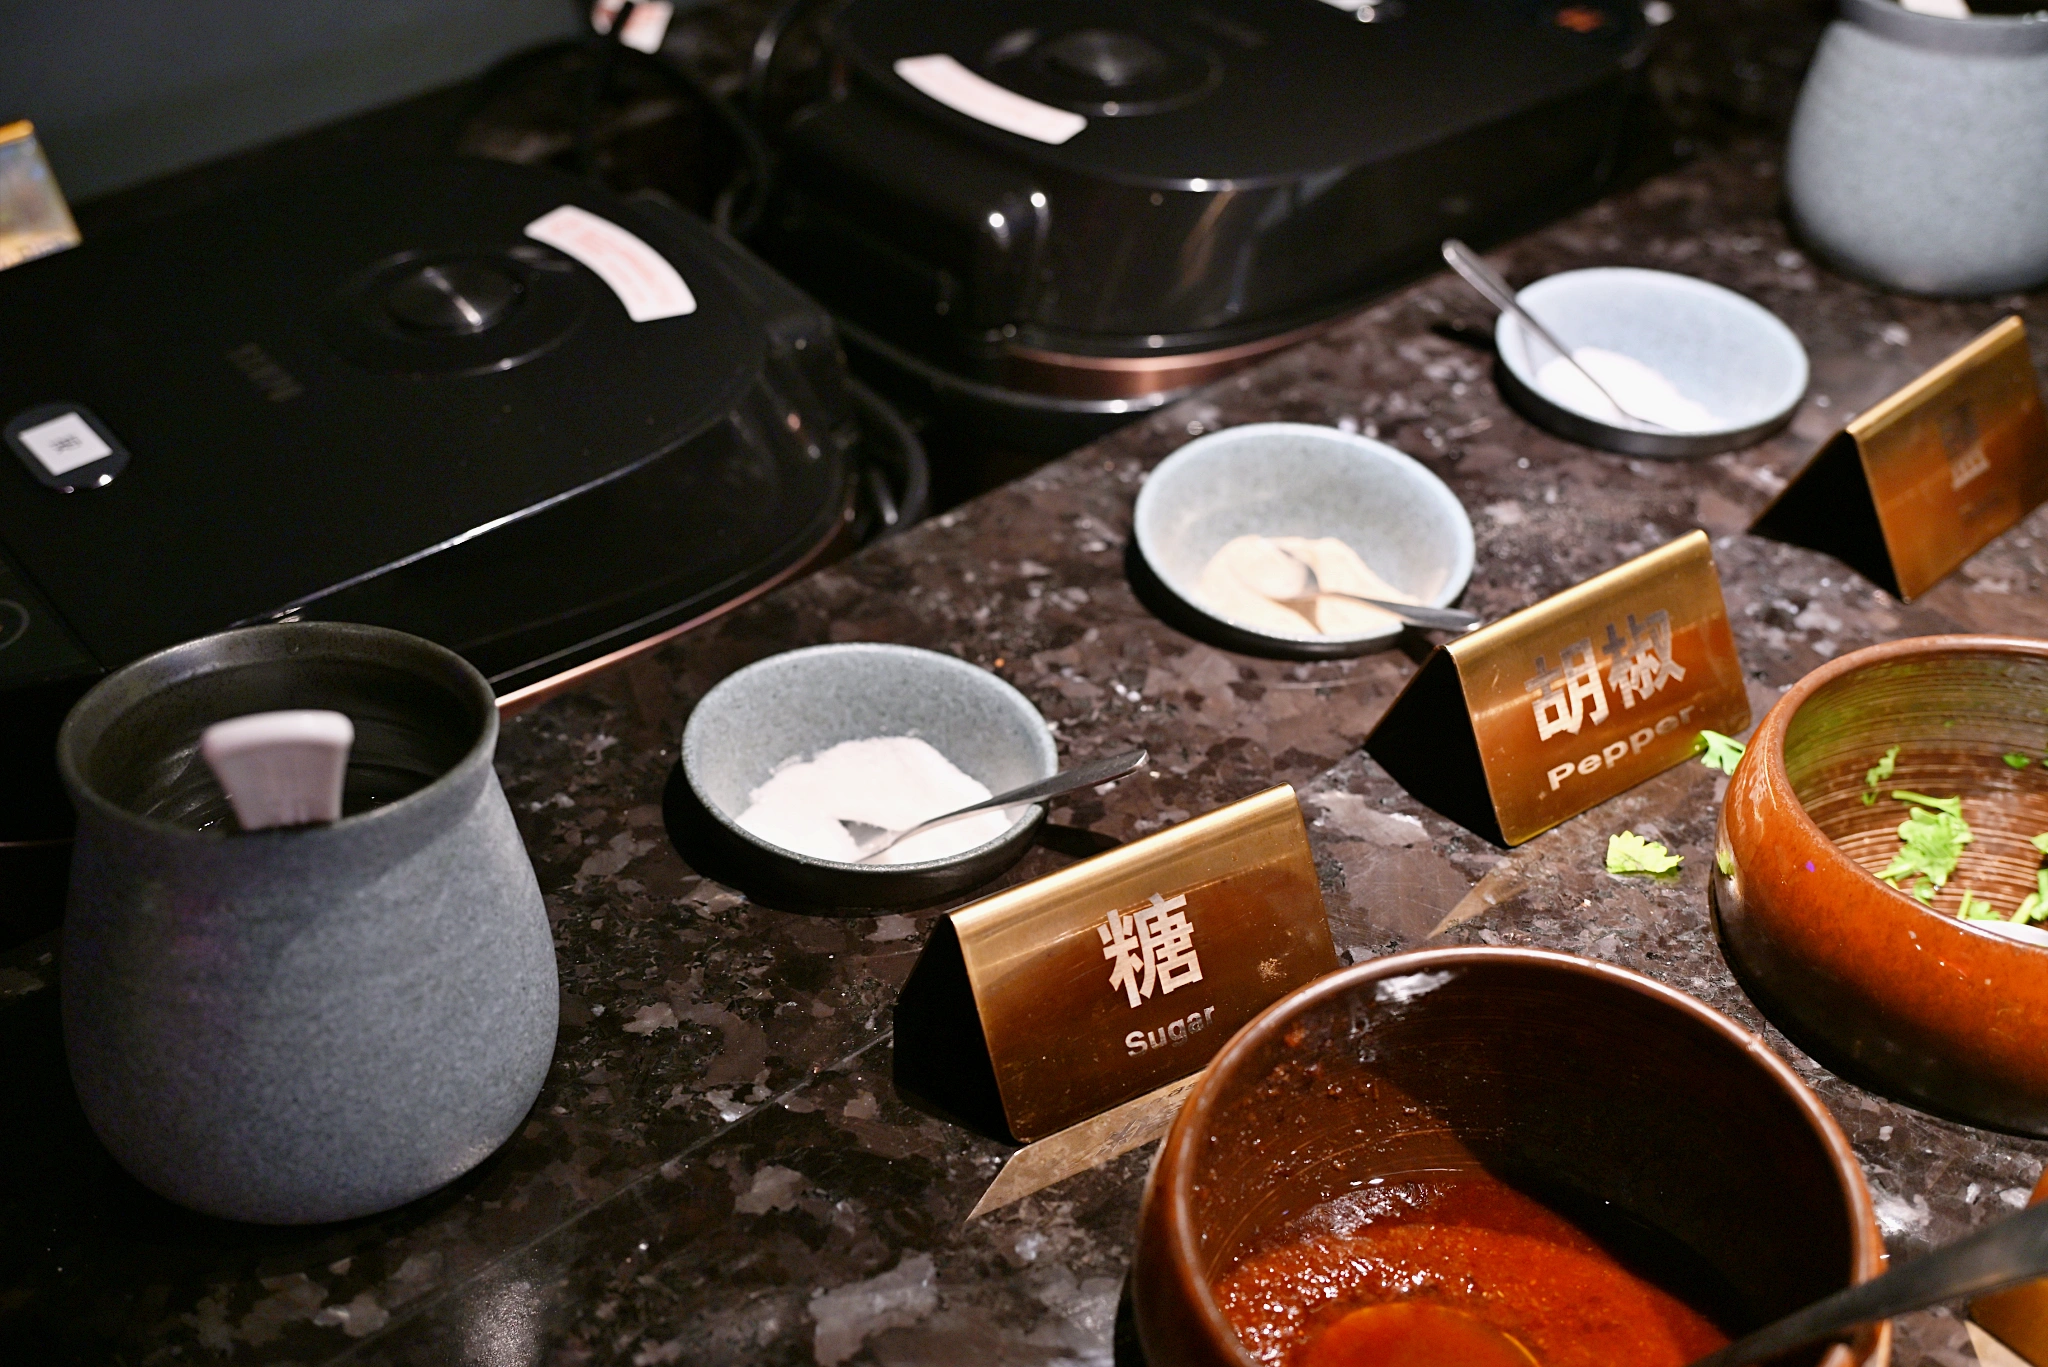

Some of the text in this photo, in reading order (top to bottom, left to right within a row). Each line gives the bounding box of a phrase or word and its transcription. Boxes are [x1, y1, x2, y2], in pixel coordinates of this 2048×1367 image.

[1524, 608, 1686, 742] 胡椒
[1547, 704, 1695, 791] Pepper
[1097, 892, 1203, 1009] 糖
[1124, 1004, 1216, 1057] Sugar
